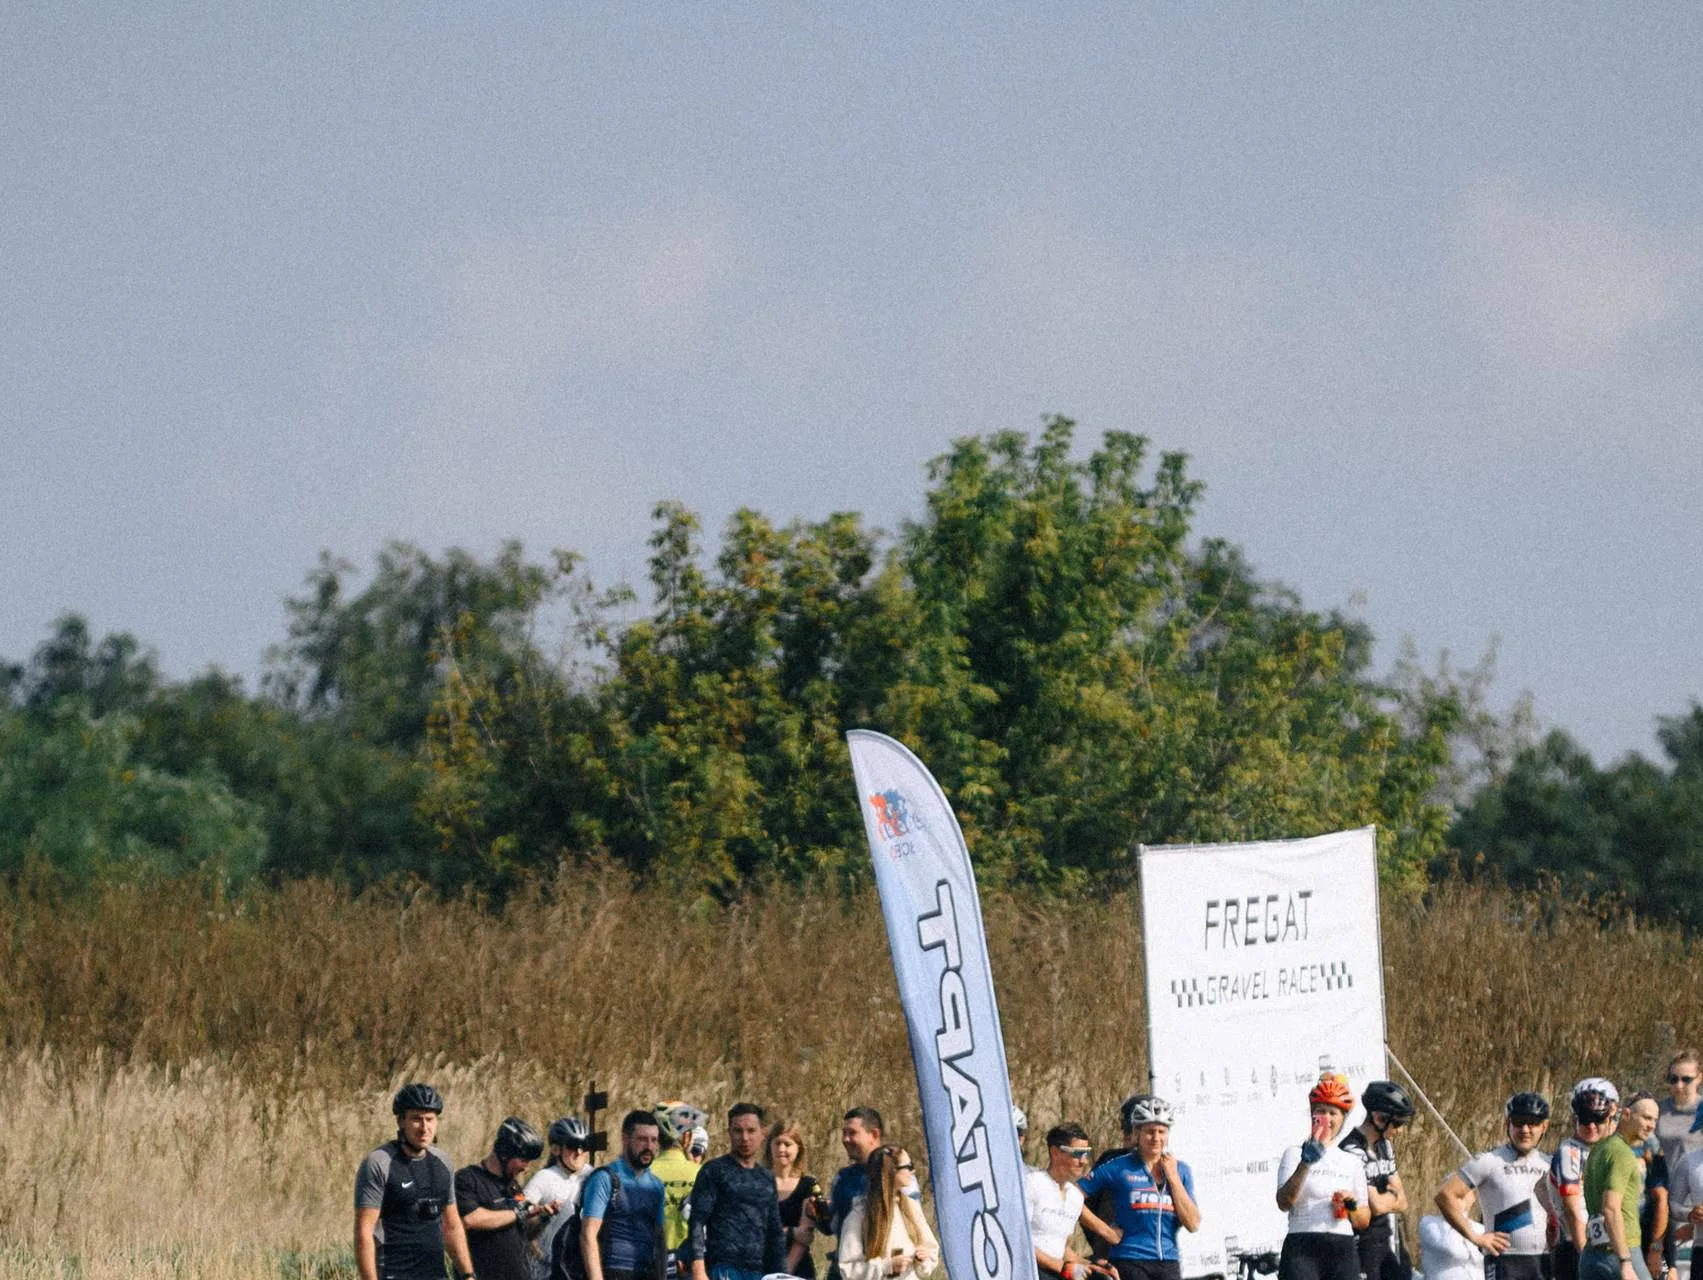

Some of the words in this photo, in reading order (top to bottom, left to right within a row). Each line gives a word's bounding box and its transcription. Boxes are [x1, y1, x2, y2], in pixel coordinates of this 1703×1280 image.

[1205, 890, 1313, 949] FREGAT
[1207, 970, 1269, 1004] GRAVEL
[1278, 965, 1317, 995] RACE
[1504, 1165, 1543, 1176] STRAV
